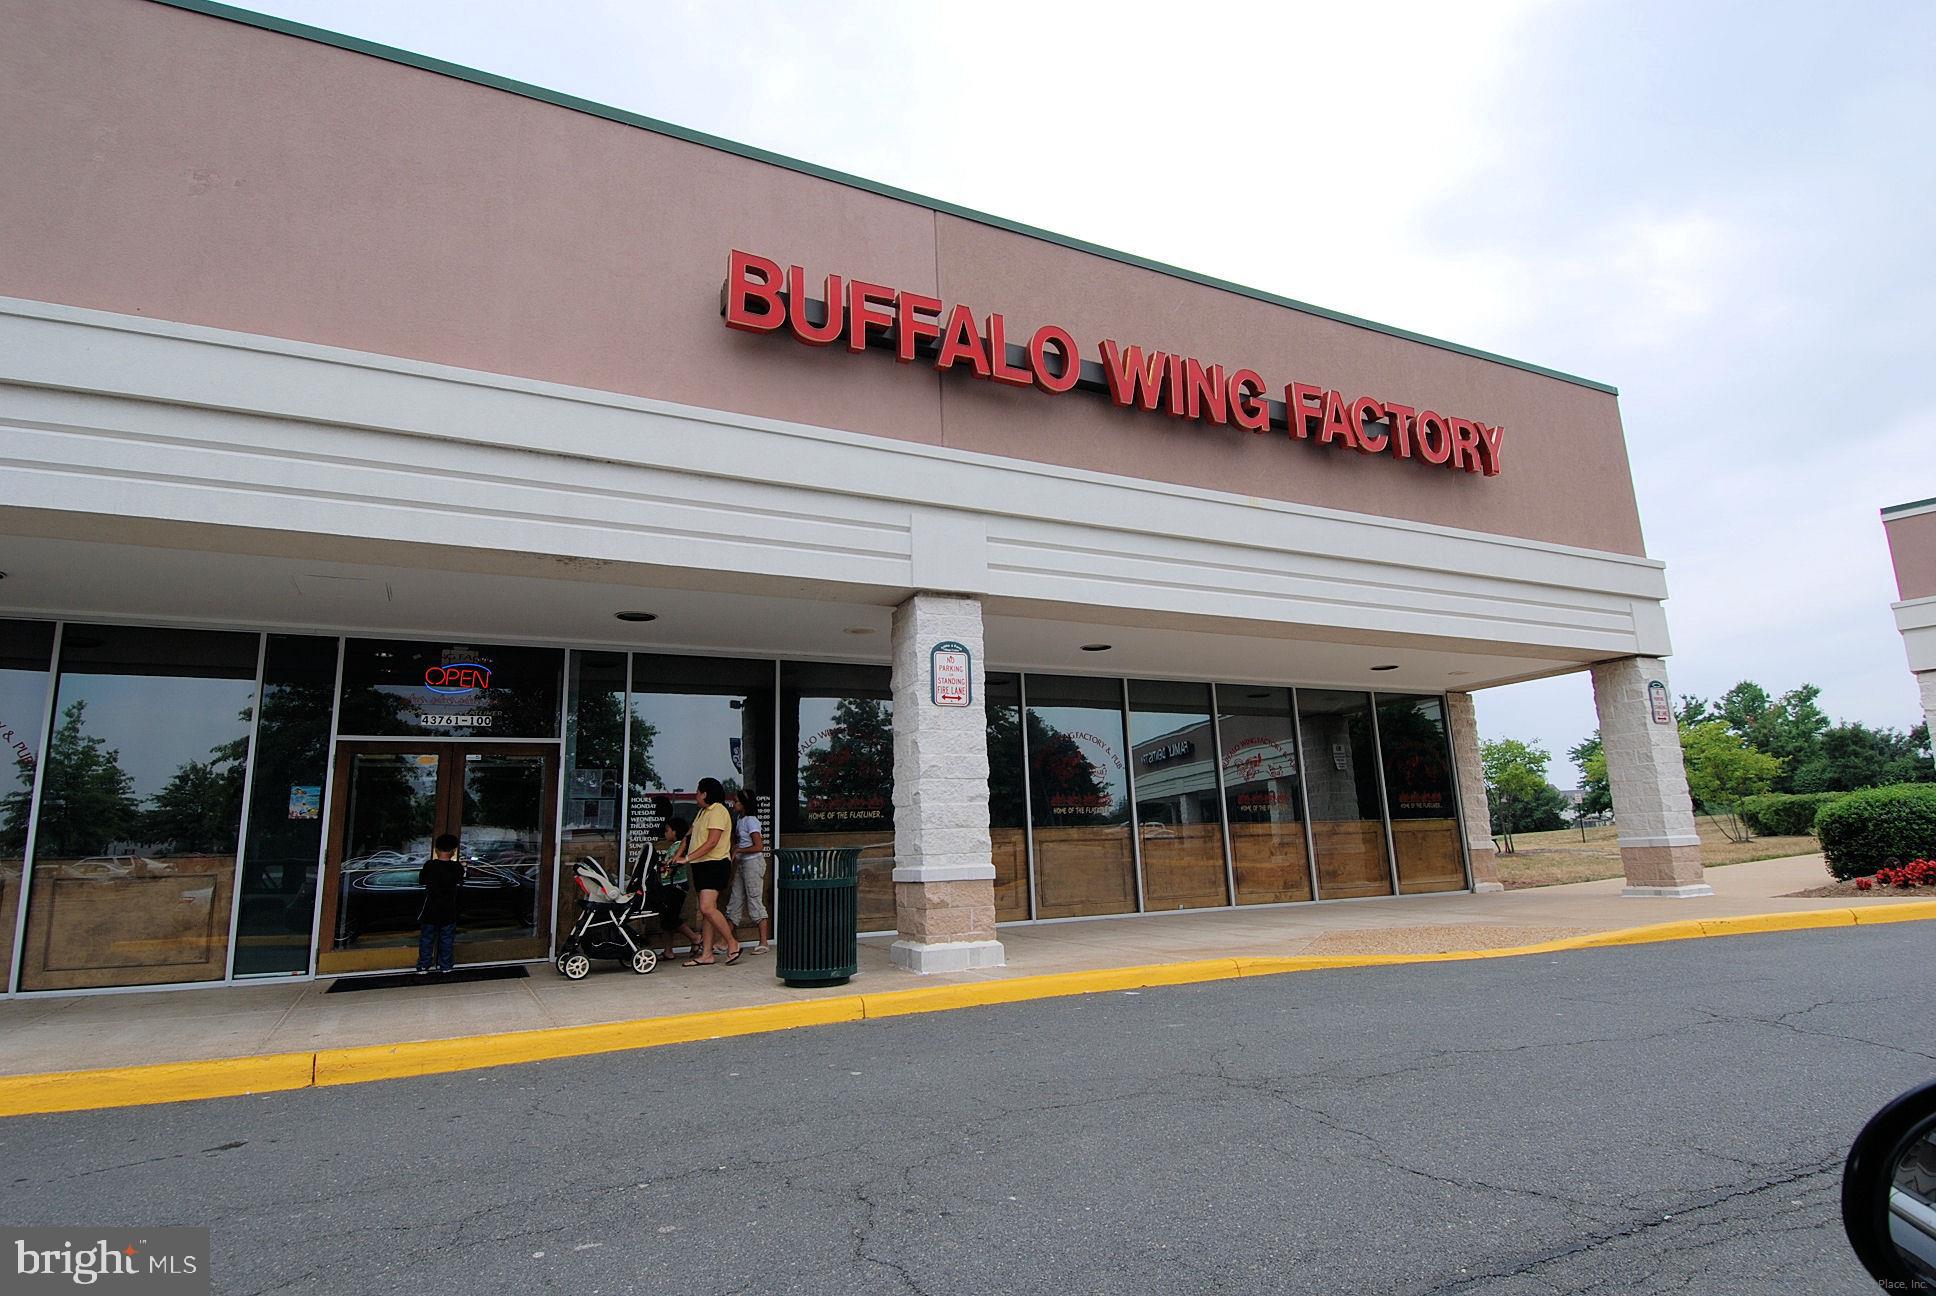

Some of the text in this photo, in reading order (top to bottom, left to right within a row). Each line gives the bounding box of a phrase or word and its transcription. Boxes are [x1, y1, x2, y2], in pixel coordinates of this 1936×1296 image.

[723, 248, 1505, 477] BUFFALO WING FACTORY
[946, 656, 955, 664] NO
[938, 665, 963, 673] PARKING
[425, 667, 490, 689] OPEN
[937, 677, 965, 686] STANDING
[937, 686, 966, 696] FIRE LANE
[421, 716, 491, 725] 43761-100
[2, 730, 14, 743] &
[1076, 732, 1106, 750] FACTORY
[809, 812, 825, 820] HOME
[827, 811, 836, 819] OF
[837, 811, 847, 819] THE
